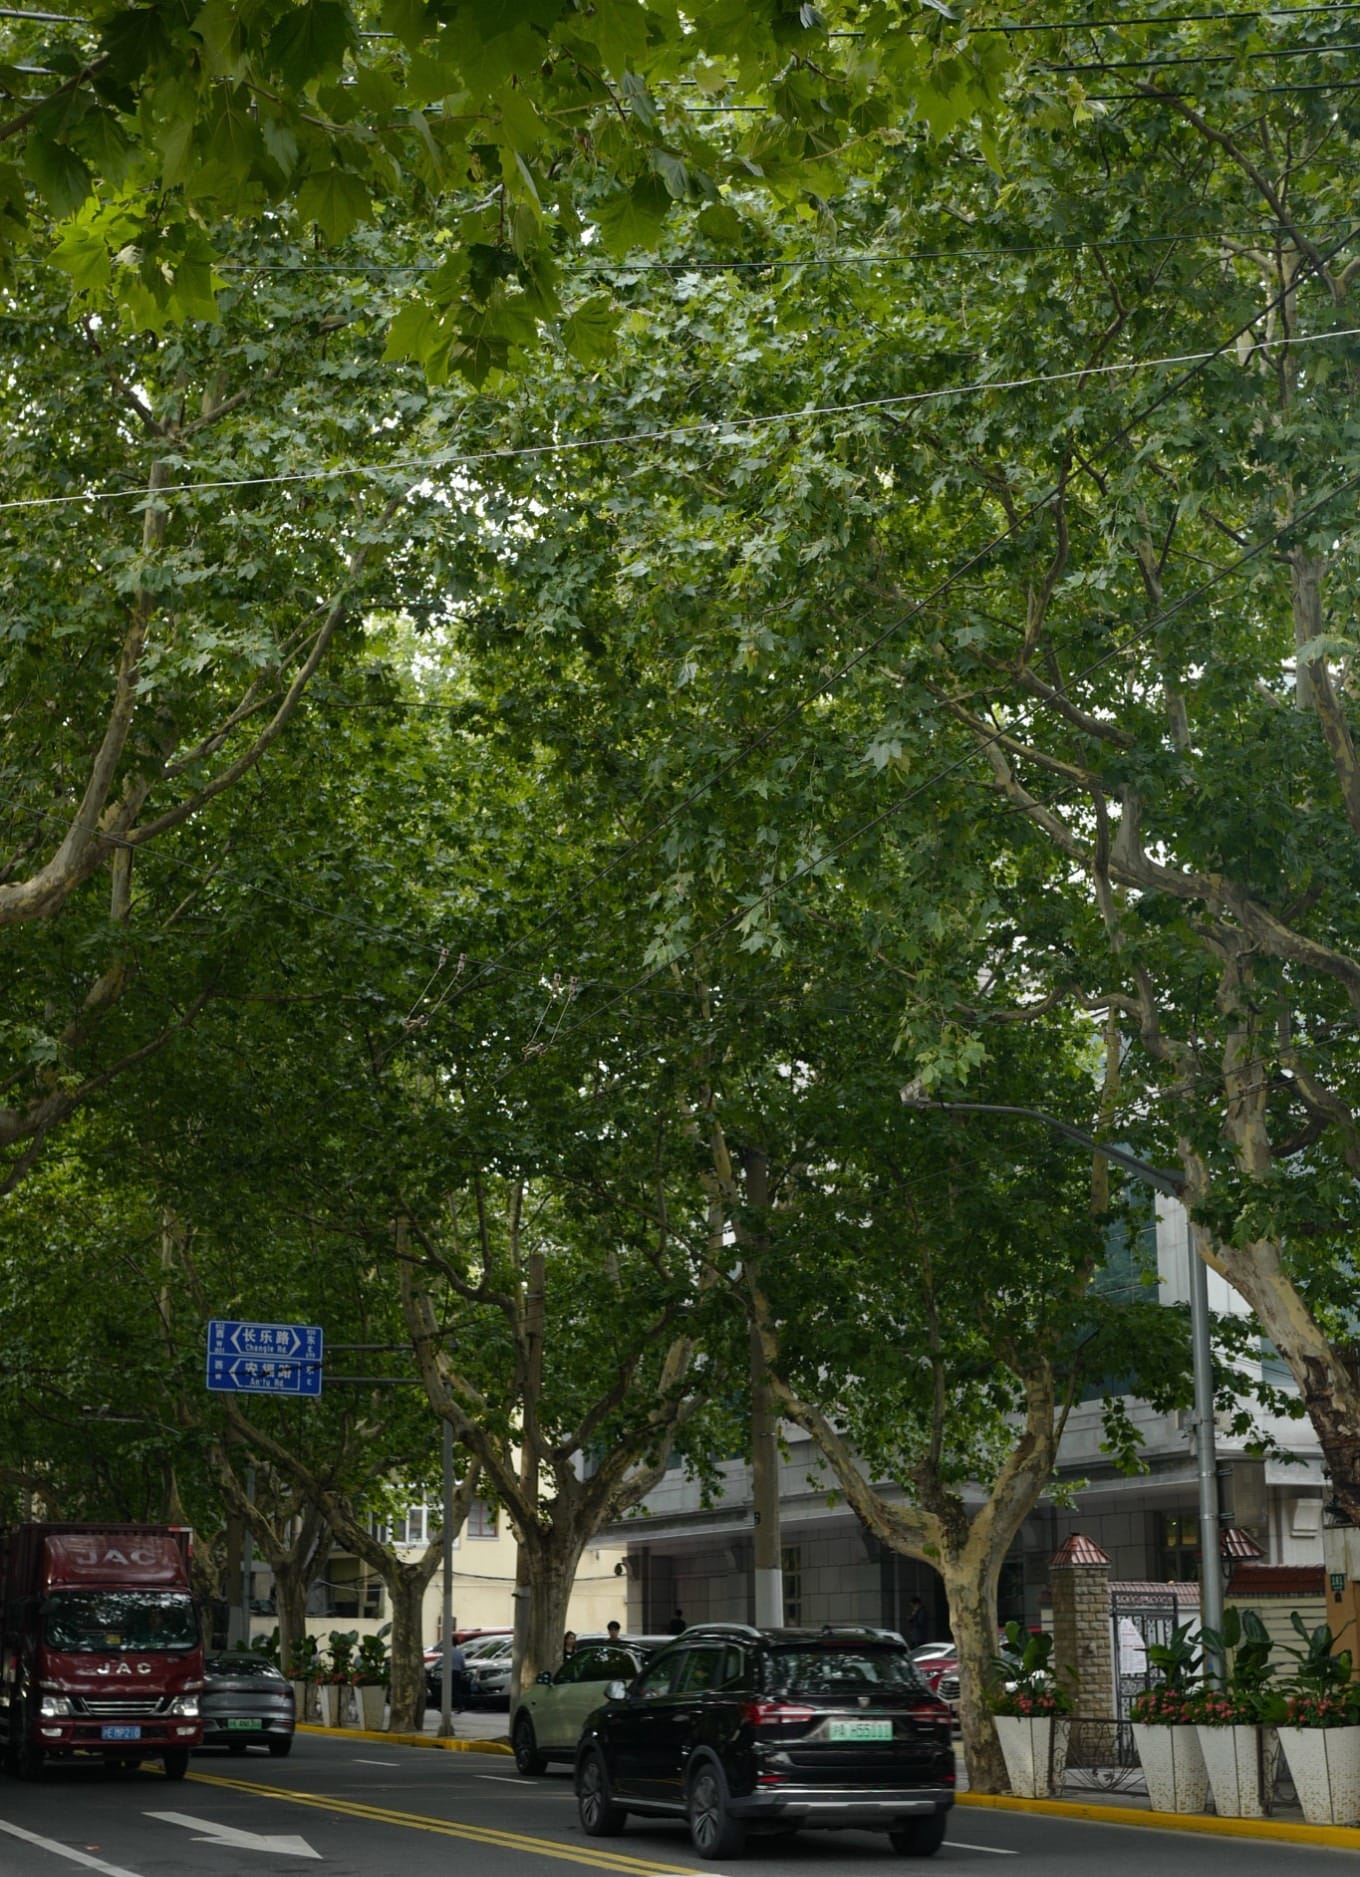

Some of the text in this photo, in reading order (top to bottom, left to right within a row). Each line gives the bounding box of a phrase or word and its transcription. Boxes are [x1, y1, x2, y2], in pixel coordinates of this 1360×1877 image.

[243, 1328, 289, 1345] 长乐路
[246, 1344, 274, 1354] Changle
[245, 1362, 292, 1379] 安福路
[76, 1549, 156, 1566] JAC
[97, 1662, 151, 1674] JAC
